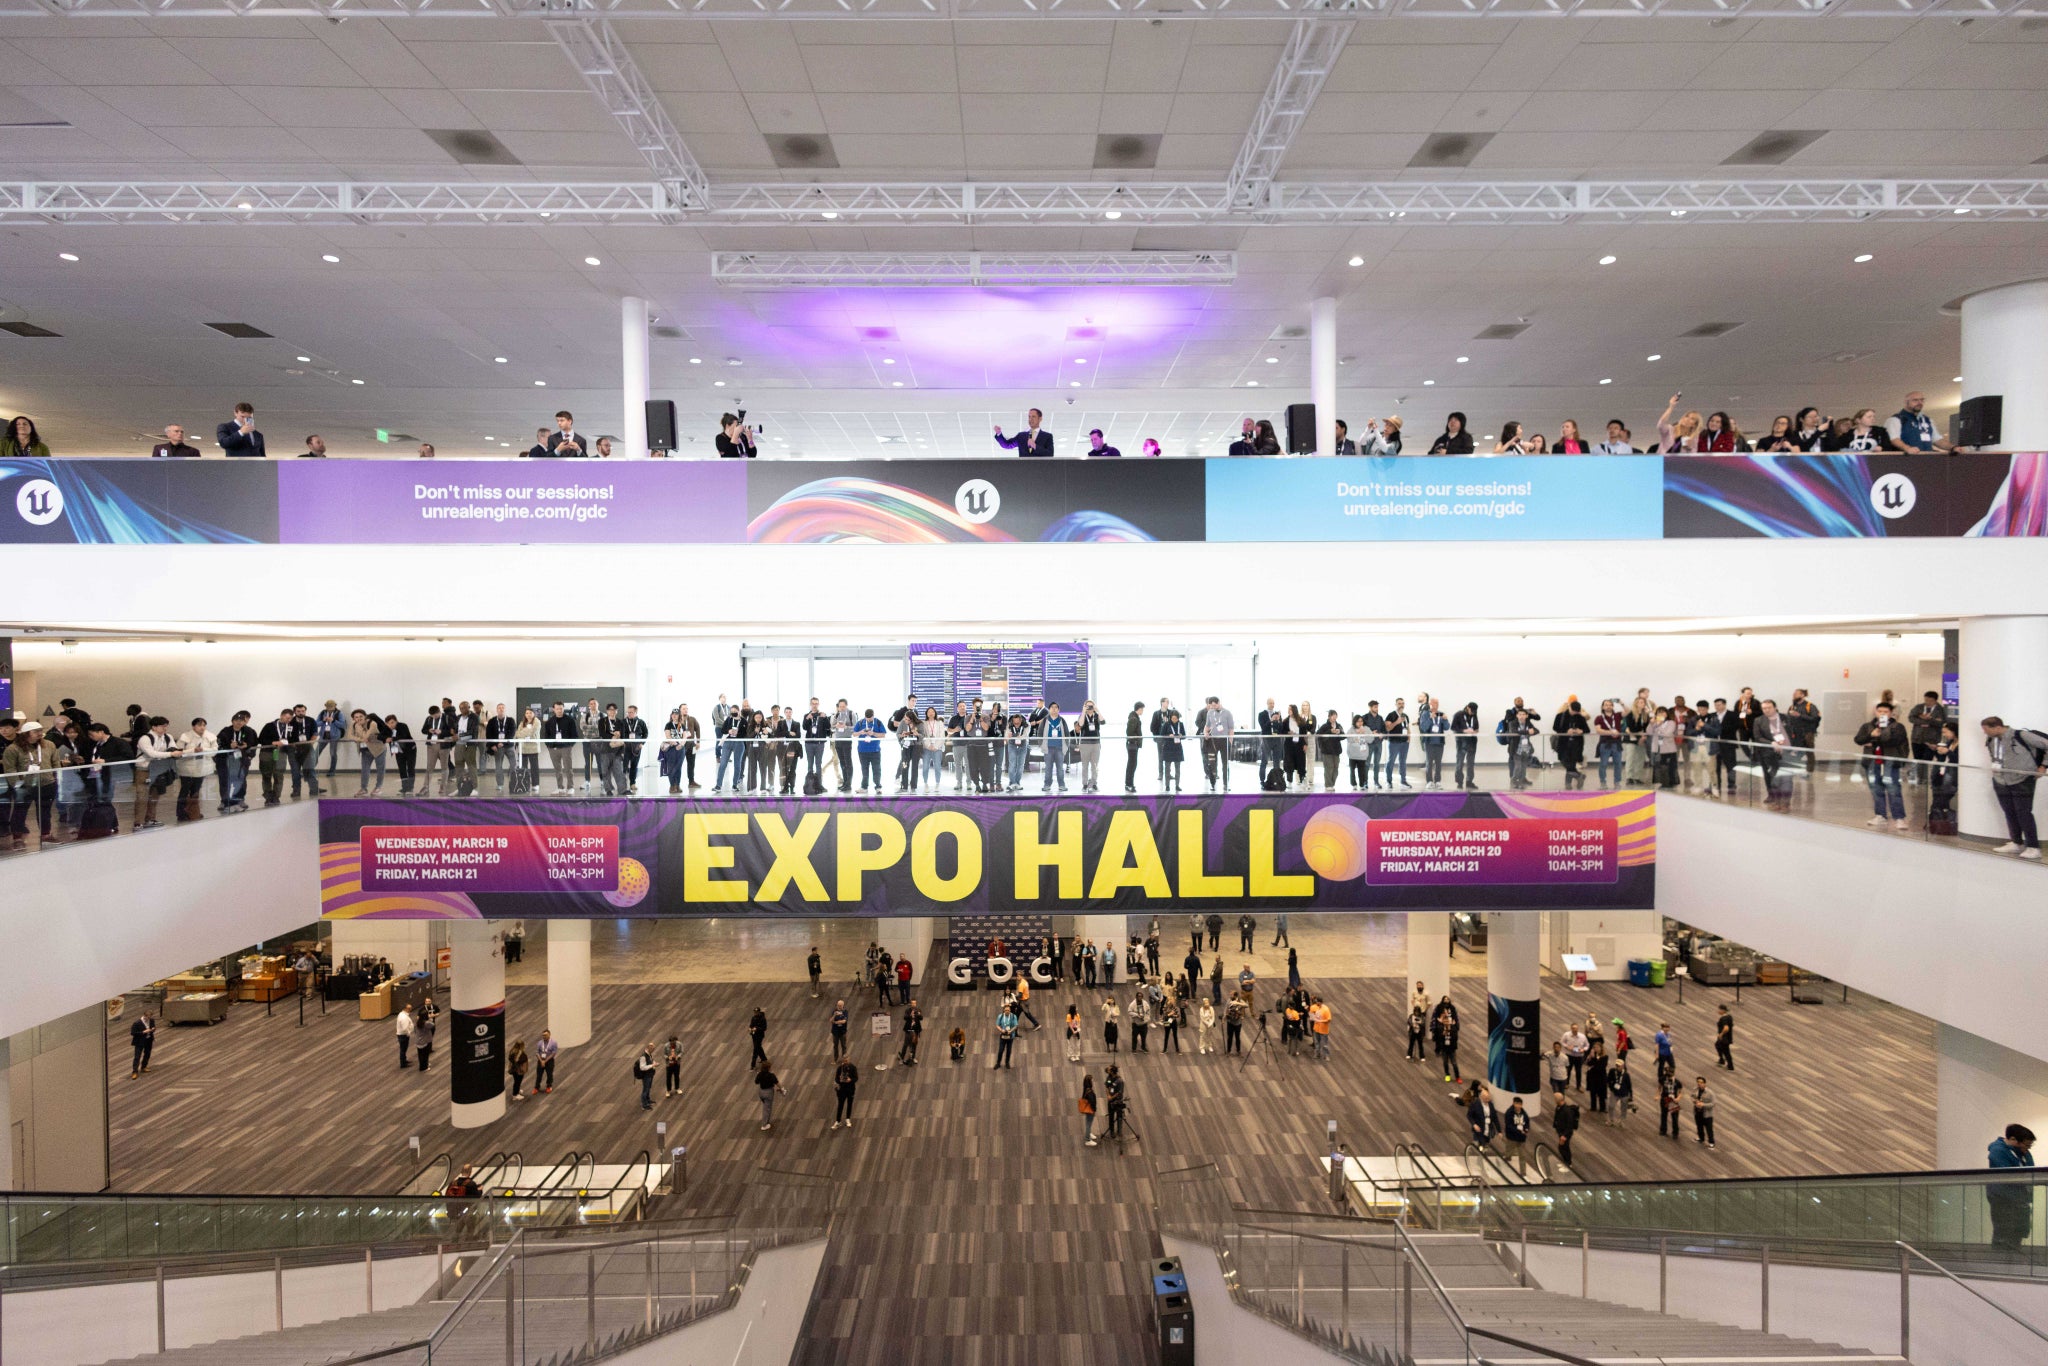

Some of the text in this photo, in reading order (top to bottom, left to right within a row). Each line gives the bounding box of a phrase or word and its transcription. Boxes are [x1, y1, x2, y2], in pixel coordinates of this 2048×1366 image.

[414, 484, 614, 500] Don't miss our sessions!
[1336, 481, 1532, 497] Don't miss our sessions!
[422, 503, 608, 523] unrealengine.com/gdc
[1343, 500, 1525, 519] unrealengine.com/gdc
[375, 837, 604, 850] WEDNESDAY, MARCH 19 10AM-6PM
[1380, 829, 1604, 843] WEDNESDAY, MARCH 19 10AM-6PM
[375, 852, 604, 865] THURSDAY, MARCH 20 10AM-6PM
[683, 808, 1315, 902] EXPO HALL
[1380, 845, 1604, 858] THURSDAY, MARCH 20 10AM-6PM
[375, 868, 604, 880] FRIDAY, MARCH 21 10AM-3PM
[1380, 860, 1604, 873] FRIDAY, MARCH 21 10AM-3PM
[948, 957, 1053, 984] GDC
